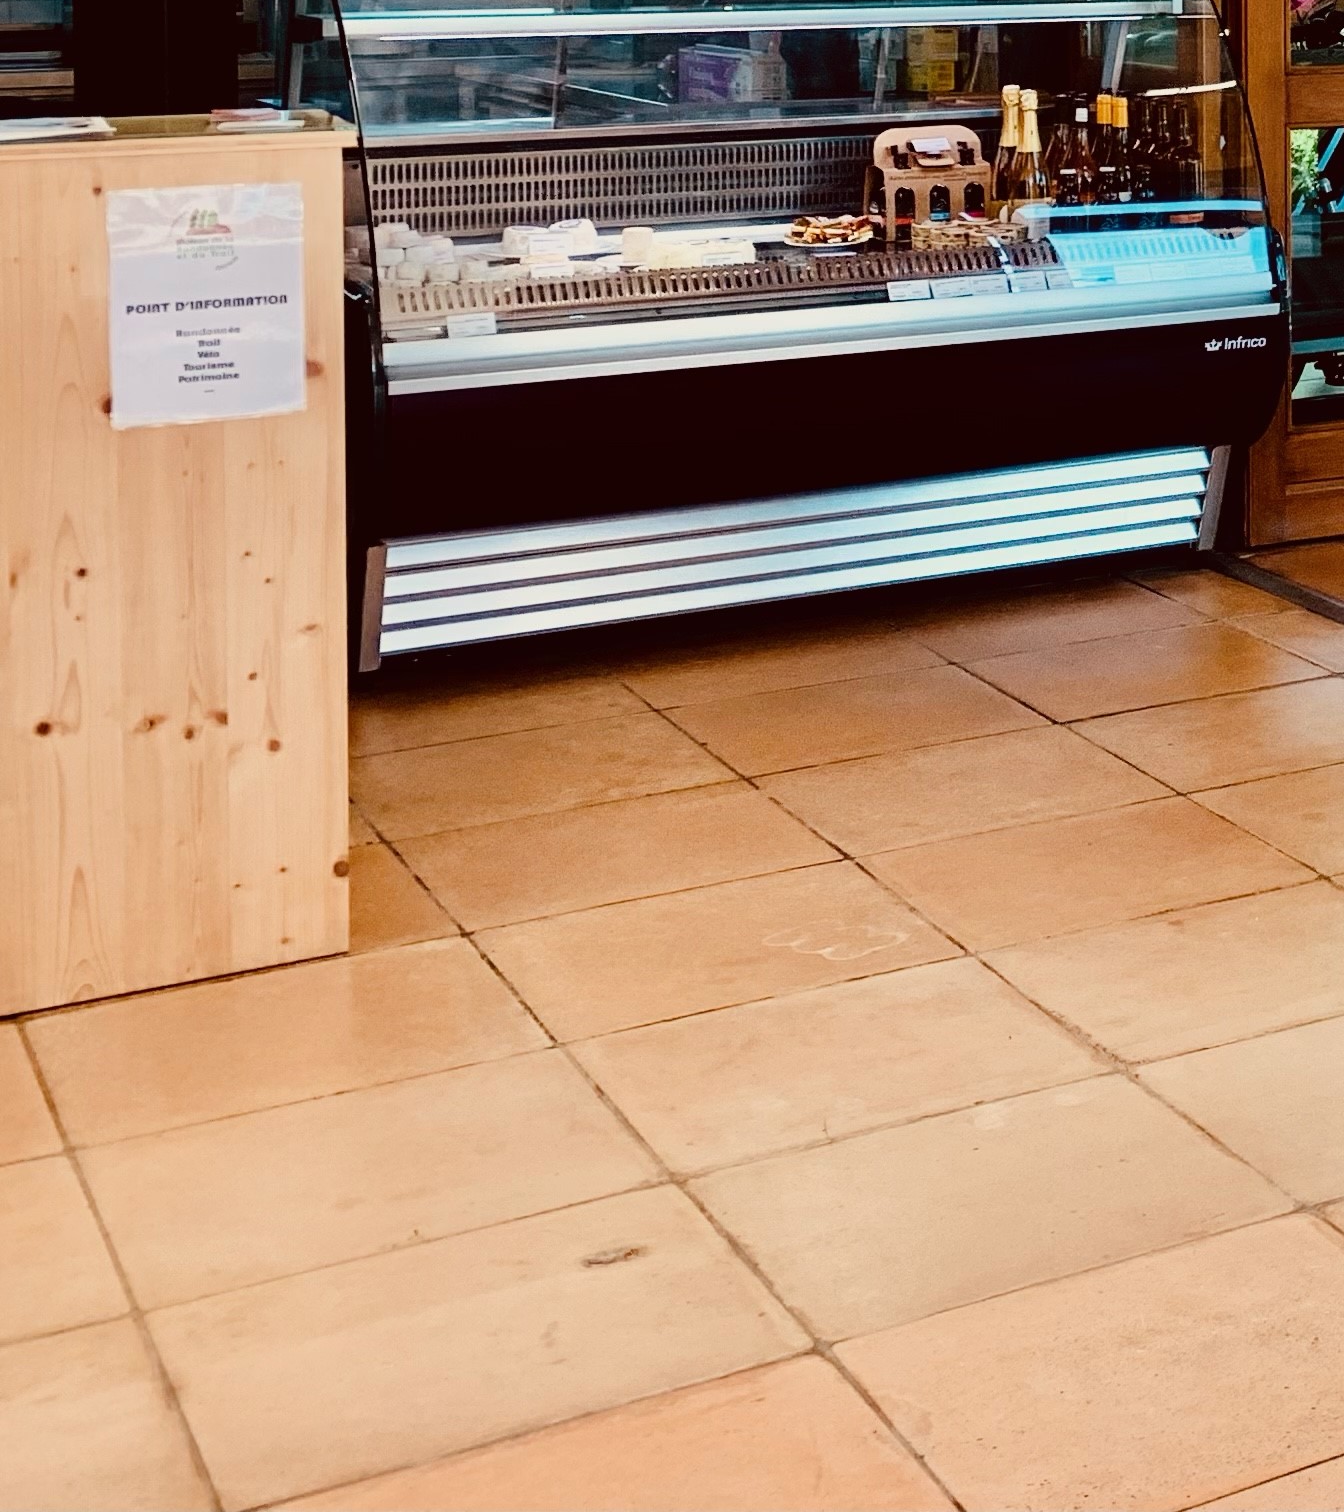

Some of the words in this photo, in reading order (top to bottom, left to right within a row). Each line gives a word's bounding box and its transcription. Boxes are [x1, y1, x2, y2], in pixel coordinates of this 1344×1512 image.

[126, 302, 170, 315] POINT
[198, 338, 221, 347] Trail
[184, 361, 235, 371] Tourisme
[178, 372, 240, 383] Patrimoine
